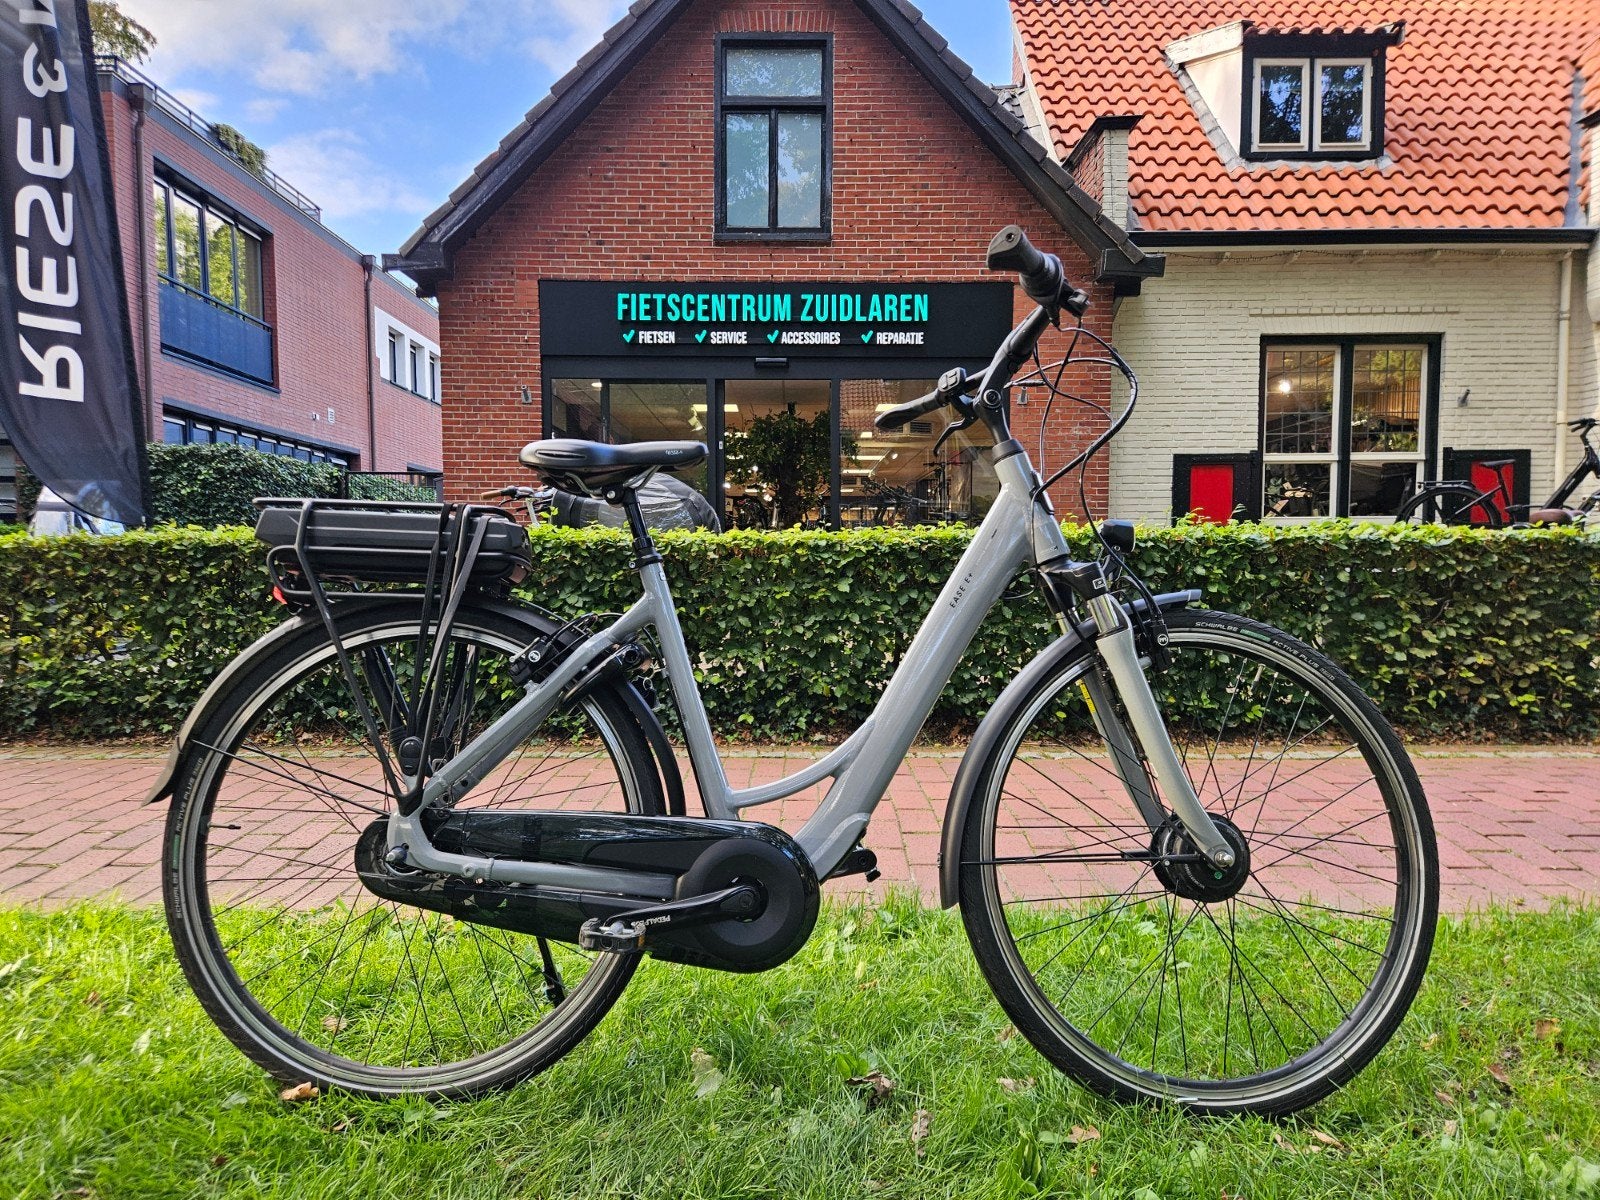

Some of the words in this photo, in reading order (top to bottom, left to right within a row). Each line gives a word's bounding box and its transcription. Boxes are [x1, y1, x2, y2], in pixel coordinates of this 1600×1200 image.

[617, 293, 792, 322] FIETSCENTRUM
[800, 294, 929, 322] ZUIDLAREN
[638, 331, 676, 344] FIETSEN
[710, 331, 748, 345] SERVICE
[781, 331, 841, 345] ACCESSOIRES
[876, 331, 925, 345] REPARATIE
[949, 585, 966, 608] EASE
[1195, 621, 1239, 632] SCHWALBE
[1272, 640, 1299, 655] ACTIVE
[1299, 653, 1320, 668] PLUS
[176, 802, 187, 832] ACTIVE
[173, 872, 183, 919] SCHWALBE
